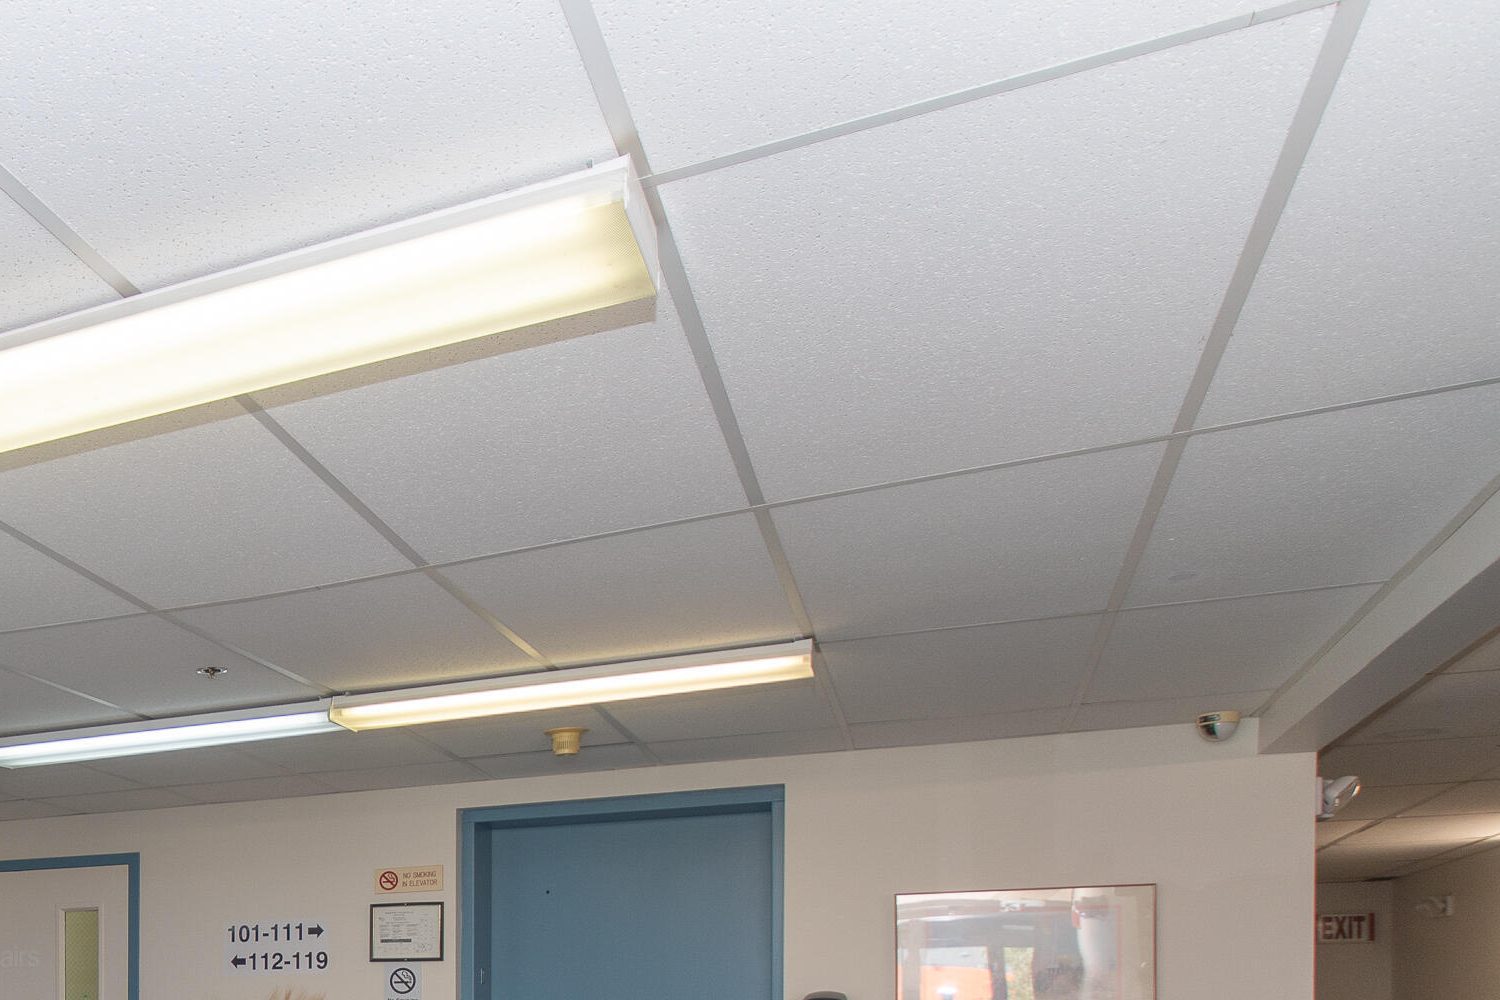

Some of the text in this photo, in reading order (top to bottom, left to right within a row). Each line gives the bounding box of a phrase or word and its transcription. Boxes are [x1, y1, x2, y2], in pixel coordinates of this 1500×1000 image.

[409, 879, 437, 887] ELEVATOR
[228, 923, 303, 942] 101-111
[1322, 916, 1365, 940] EXIT
[249, 951, 328, 970] 112-119
